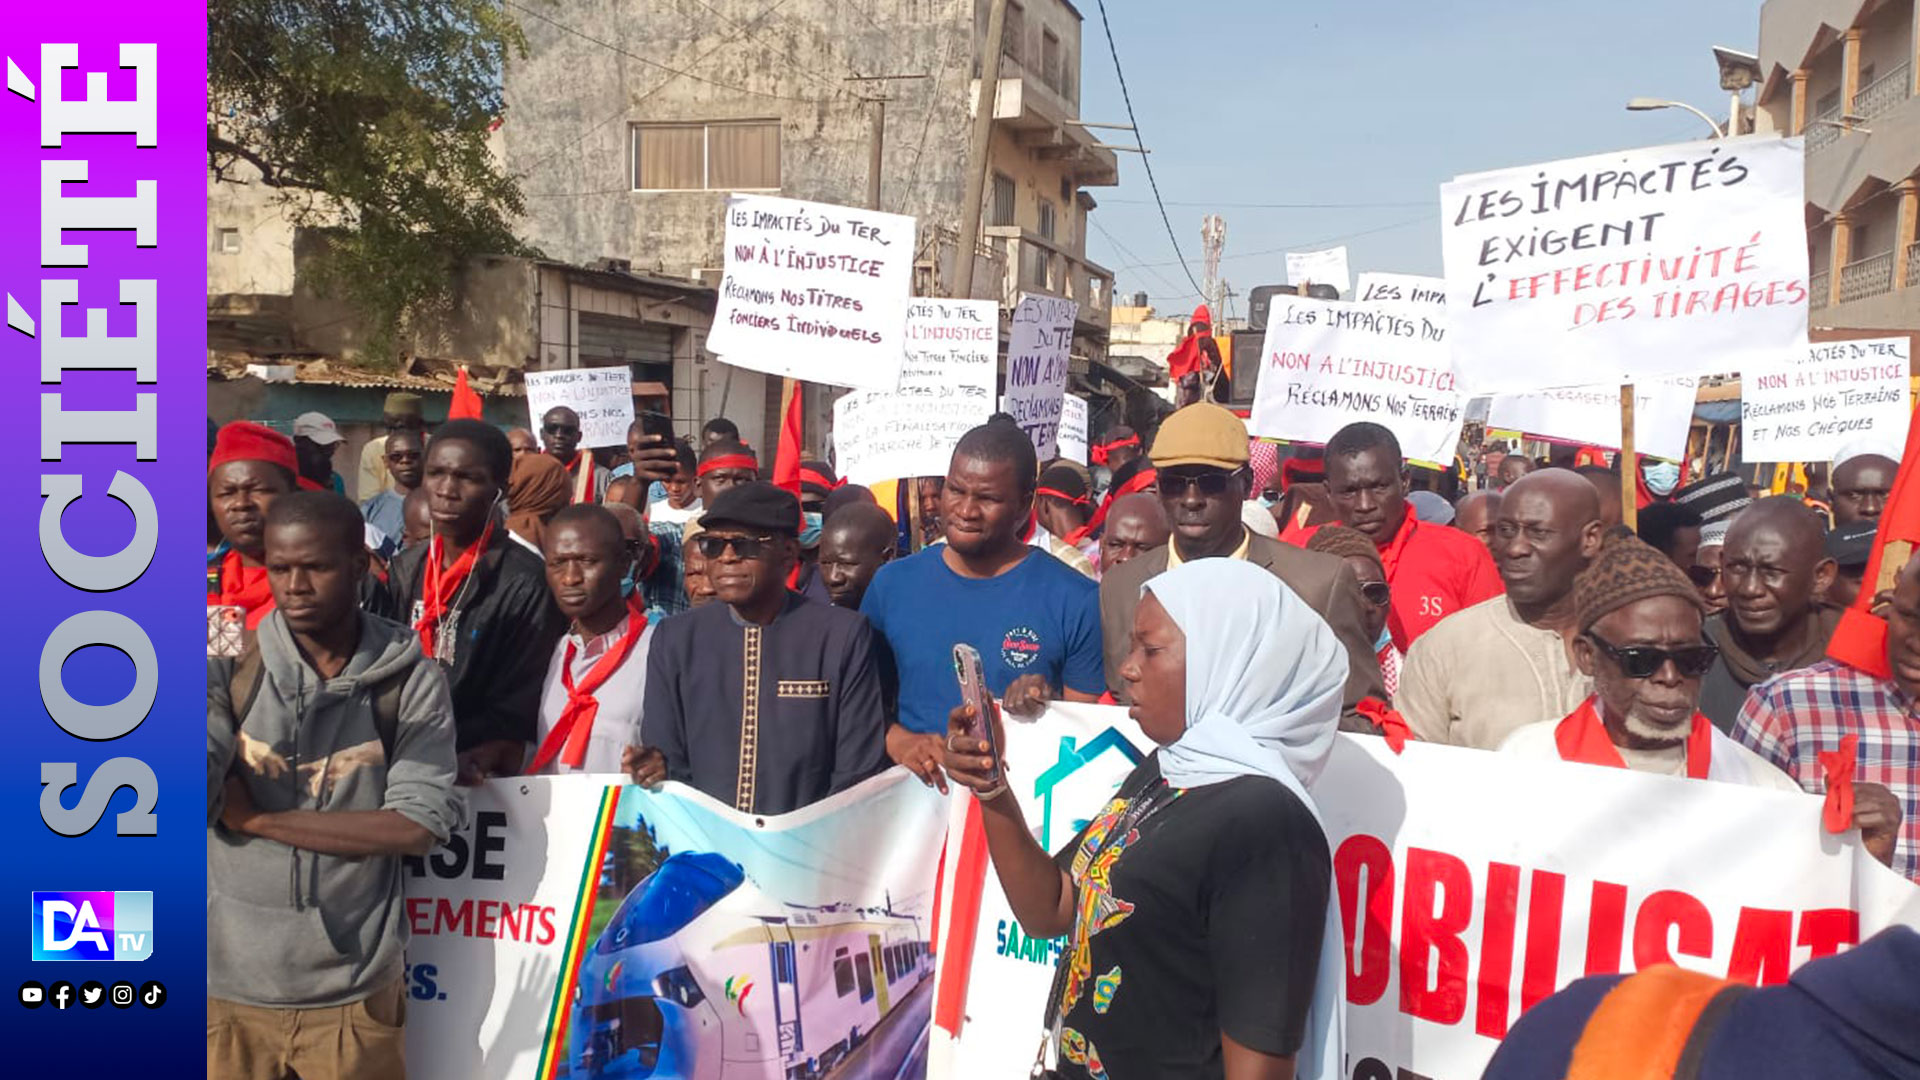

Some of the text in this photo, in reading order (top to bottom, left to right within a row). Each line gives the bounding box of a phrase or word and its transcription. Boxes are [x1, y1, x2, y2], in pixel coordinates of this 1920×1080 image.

[1454, 147, 1749, 227] LES IMPACTÉS
[731, 208, 748, 227] LES
[752, 208, 813, 231] IMPACTÉS
[847, 220, 891, 246] TER
[1478, 212, 1665, 267] EXIGENT
[735, 245, 755, 262] NON
[774, 245, 885, 278] L'INJUSTICE
[1472, 231, 1762, 308] L'EFFECTIVITÉ
[1362, 283, 1402, 301] LES
[955, 306, 982, 322] TER
[1283, 304, 1316, 324] LES
[1568, 296, 1636, 331] DES
[913, 324, 993, 341] L'INJUSTICE
[1271, 352, 1311, 371] NON
[1319, 355, 1334, 374] A
[1868, 343, 1907, 359] TER
[1012, 355, 1041, 387] NON
[1758, 373, 1788, 390] NON
[1809, 364, 1902, 385] L'INJUSTICE
[1812, 393, 1837, 412] NOS
[1752, 428, 1768, 441] ET
[1775, 424, 1801, 441] NOS
[1419, 596, 1443, 617] 3S
[405, 963, 447, 1000] S.
